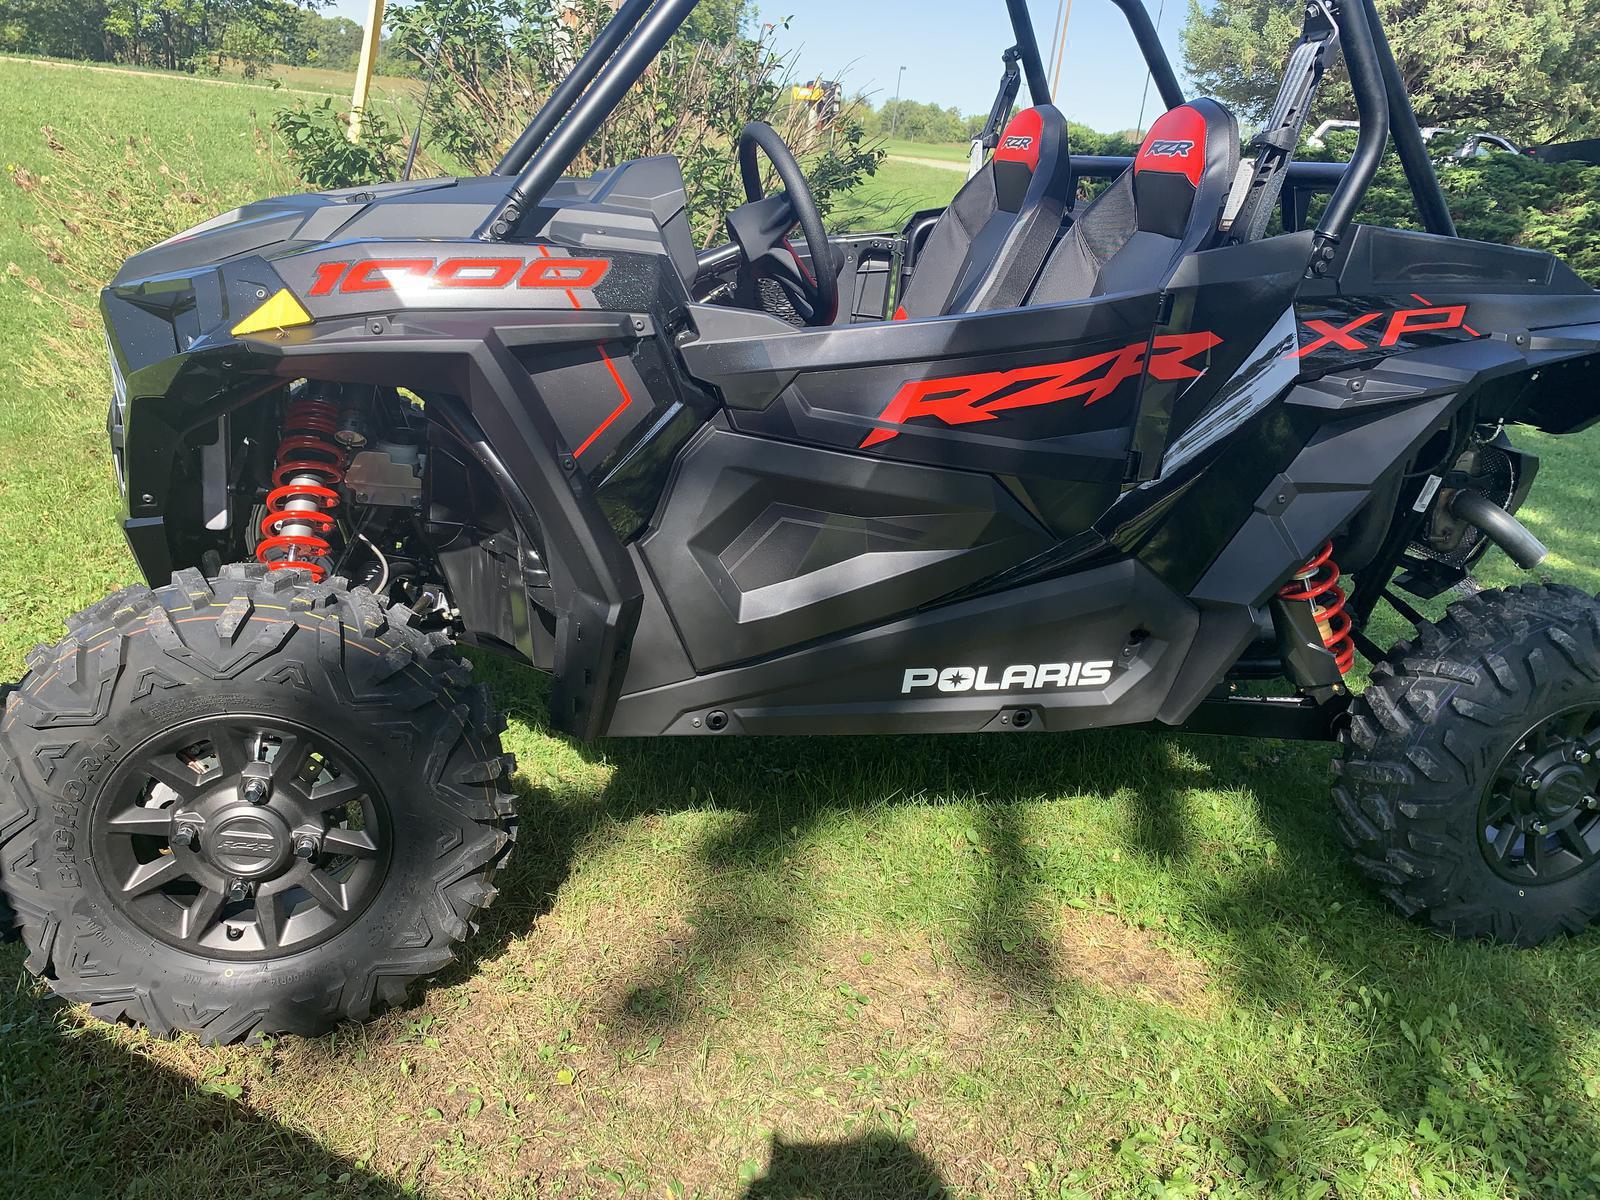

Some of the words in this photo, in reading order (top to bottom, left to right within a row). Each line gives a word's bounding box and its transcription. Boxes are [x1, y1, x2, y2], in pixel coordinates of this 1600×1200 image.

[1001, 136, 1033, 150] RZR
[1145, 140, 1195, 158] RZR
[307, 256, 611, 297] 1000
[1282, 304, 1470, 359] XP
[859, 331, 1224, 449] RZR
[901, 660, 1114, 694] POLARIS
[52, 734, 121, 889] BIGHORN
